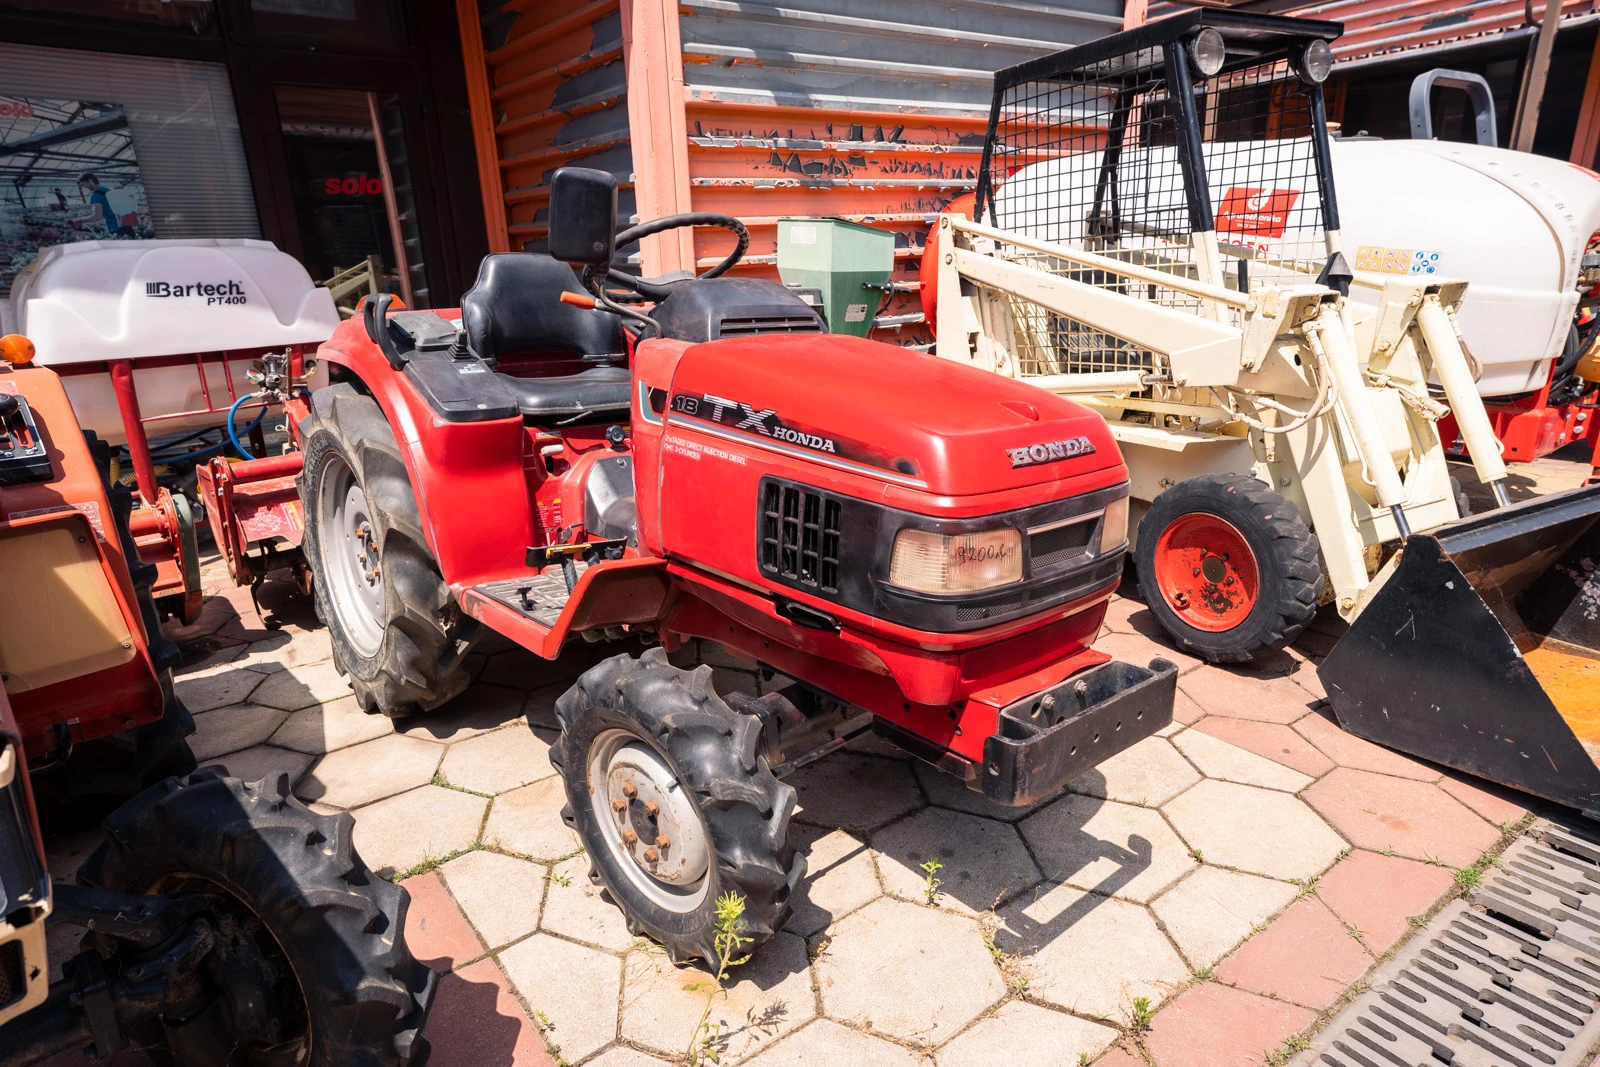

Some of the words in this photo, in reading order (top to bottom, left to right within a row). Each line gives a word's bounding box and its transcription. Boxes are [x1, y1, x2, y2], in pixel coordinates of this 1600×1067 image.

[0, 101, 34, 118] olo
[325, 174, 383, 195] solo
[146, 279, 245, 298] Bartech
[207, 296, 247, 306] PT400
[675, 395, 699, 415] 18
[703, 393, 777, 436] TX
[772, 426, 836, 453] HONDA
[686, 440, 704, 452] DIRECT
[703, 446, 729, 460] INJECTION
[728, 453, 748, 465] DIESEL
[1006, 436, 1096, 469] HONDA
